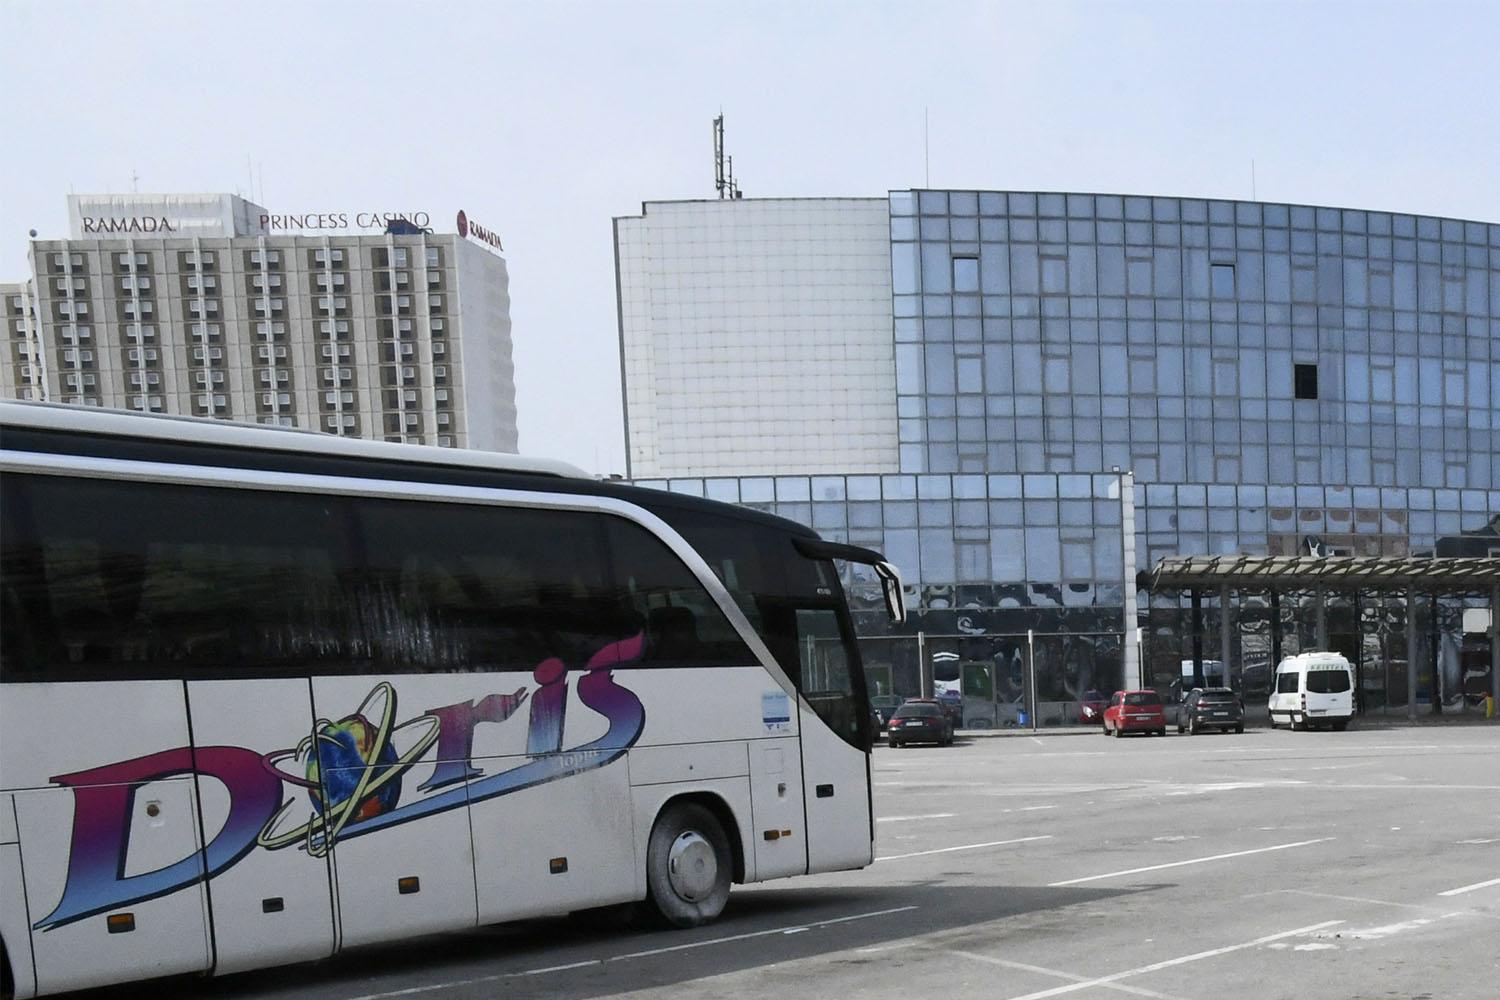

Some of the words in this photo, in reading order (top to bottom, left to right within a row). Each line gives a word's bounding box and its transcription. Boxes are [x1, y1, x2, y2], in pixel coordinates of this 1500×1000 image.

[83, 216, 173, 233] RAMADA
[259, 213, 349, 230] PRINCESS
[469, 220, 503, 251] RAMADA
[34, 630, 646, 931] Doris
